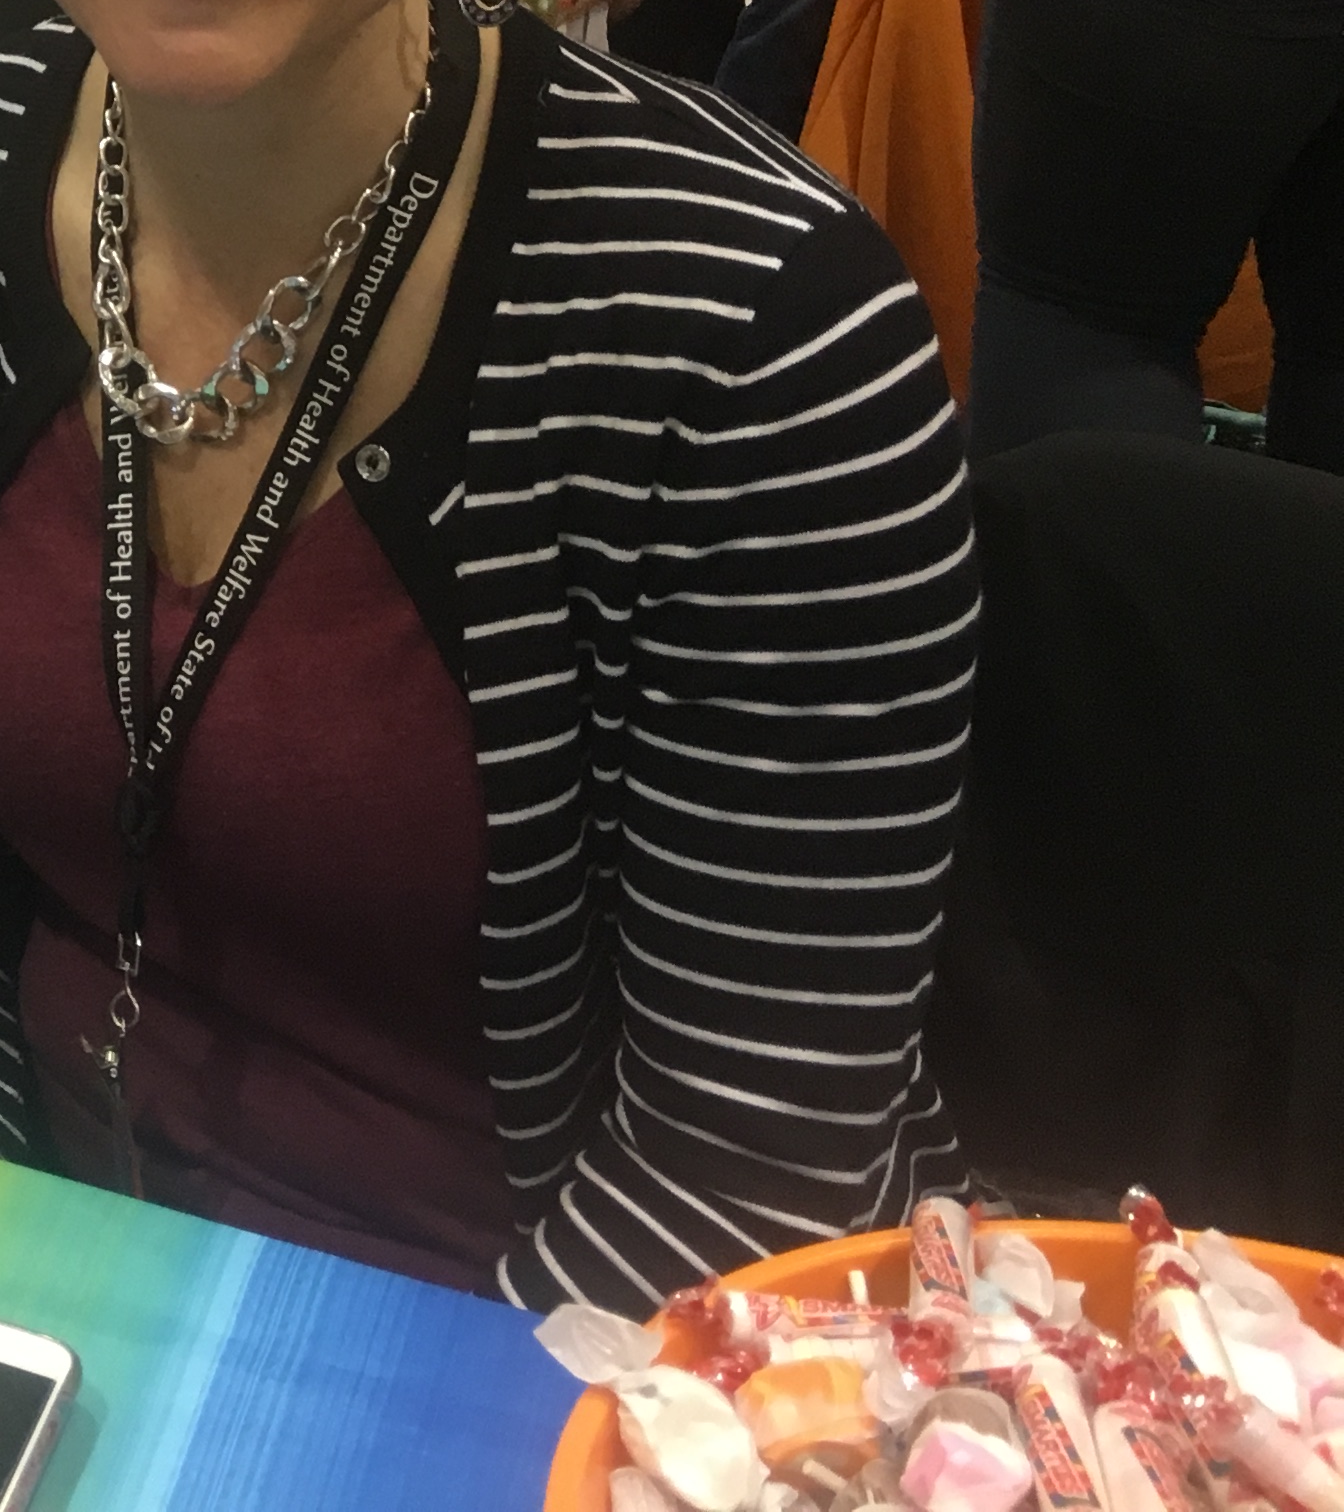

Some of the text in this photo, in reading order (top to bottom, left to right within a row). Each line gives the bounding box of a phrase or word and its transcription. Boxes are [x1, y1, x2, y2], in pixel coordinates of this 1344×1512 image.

[108, 432, 133, 483] and
[156, 172, 439, 743] Department of Health and Welfare State of
[107, 492, 133, 582] Health
[106, 589, 132, 619] of
